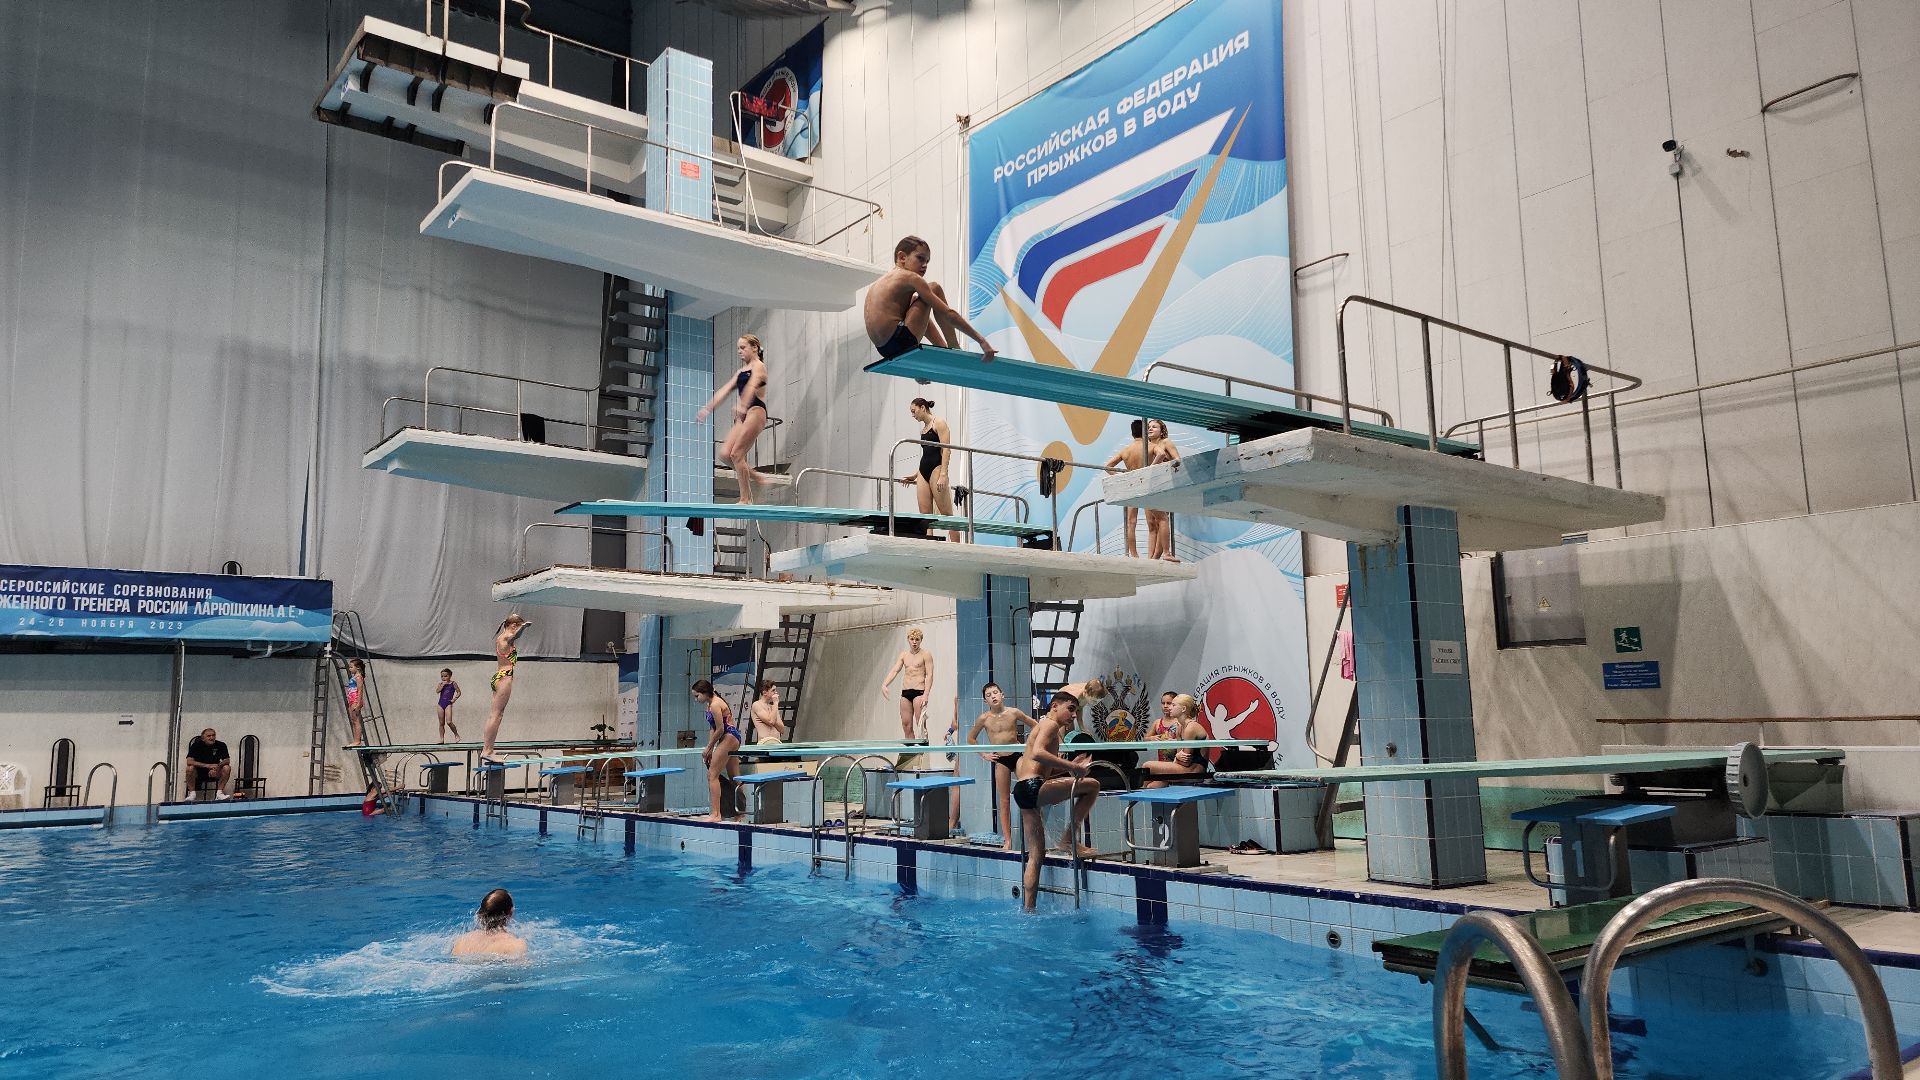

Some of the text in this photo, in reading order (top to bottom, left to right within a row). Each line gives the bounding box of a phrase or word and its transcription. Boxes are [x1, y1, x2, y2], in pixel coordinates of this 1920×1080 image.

[994, 30, 1249, 183] РОССИЙСКАЯ ФЕДЕРАЦИЯ
[1026, 82, 1201, 187] ПРЫЖКОВ В ВОДУ
[73, 596, 131, 612] ТРЕНЕРА
[138, 599, 188, 614] РОССИИ
[194, 602, 274, 617] ЛАРЮШКИНА
[113, 583, 213, 599] СОРЕВНОВАНИЯ
[81, 619, 135, 629] НОЯБРЯ
[150, 621, 183, 630] 2023
[1193, 665, 1287, 720] ЕРАЦИЯ ПРЫЖКОВ В ВОДУ
[1572, 841, 1585, 877] 1
